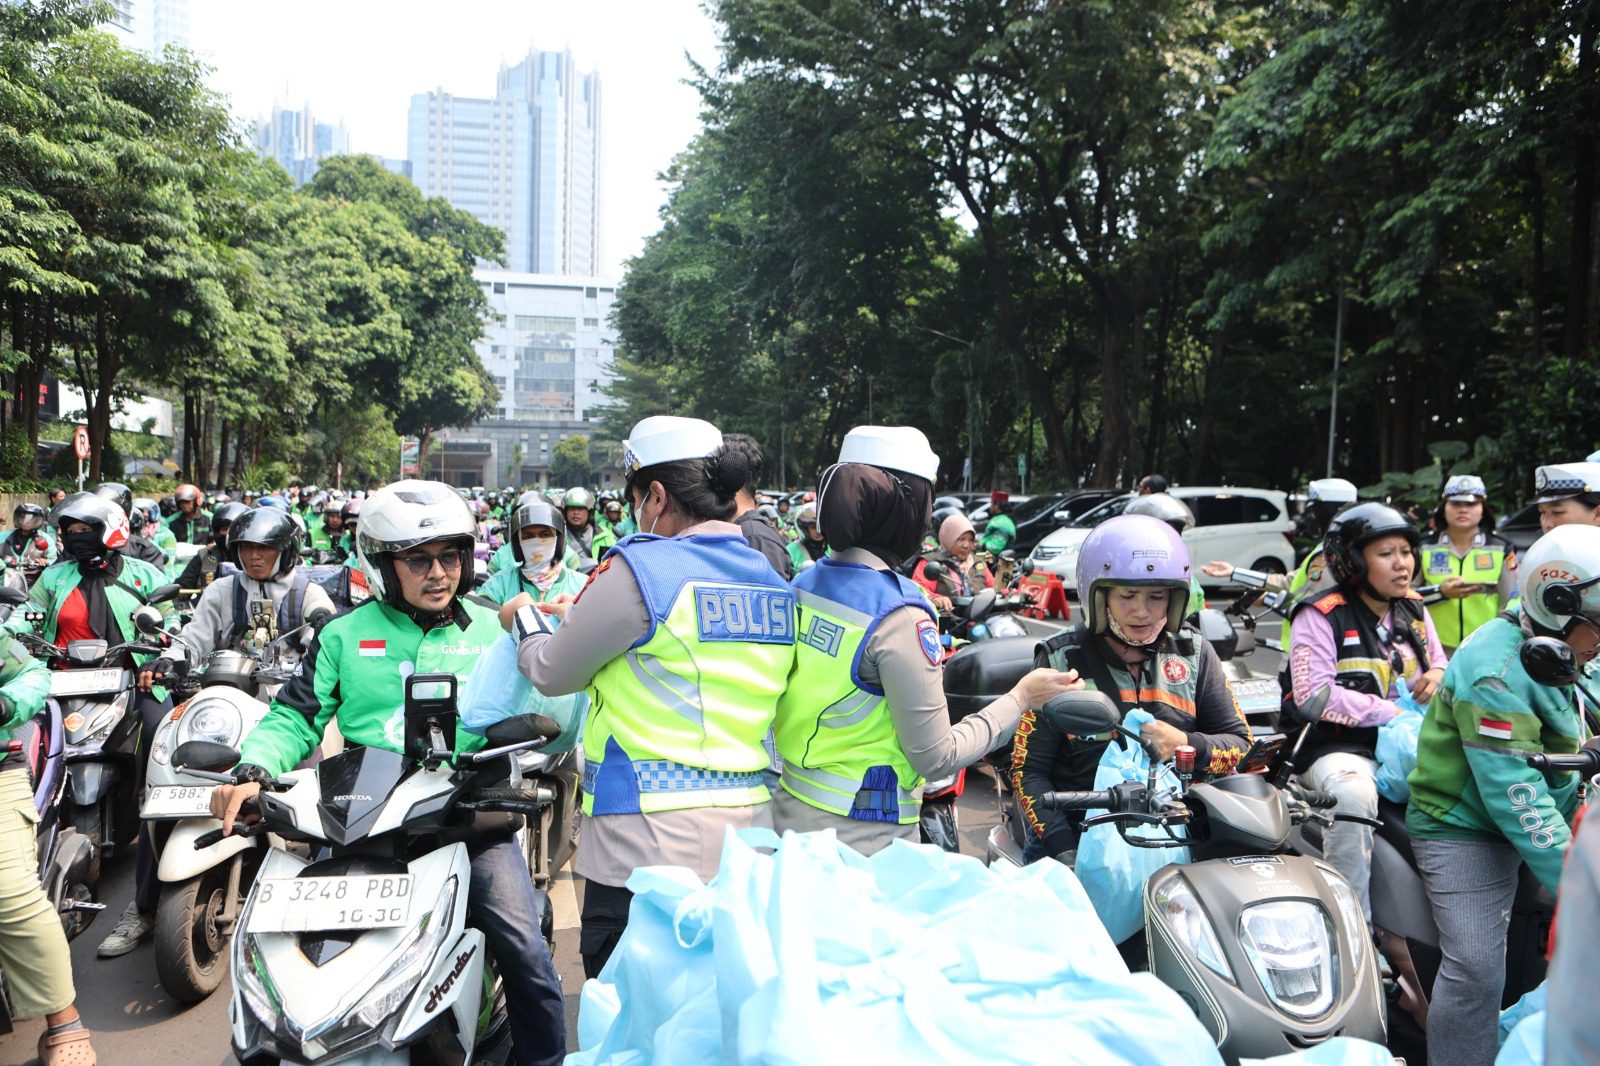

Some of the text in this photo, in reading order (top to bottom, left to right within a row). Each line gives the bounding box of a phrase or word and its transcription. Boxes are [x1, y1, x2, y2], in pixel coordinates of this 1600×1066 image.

[701, 593, 793, 637] POLISI
[152, 788, 162, 800] B
[1507, 783, 1556, 849] Grab
[259, 878, 410, 904] B 3248 PBD
[424, 944, 477, 1013] Honda
